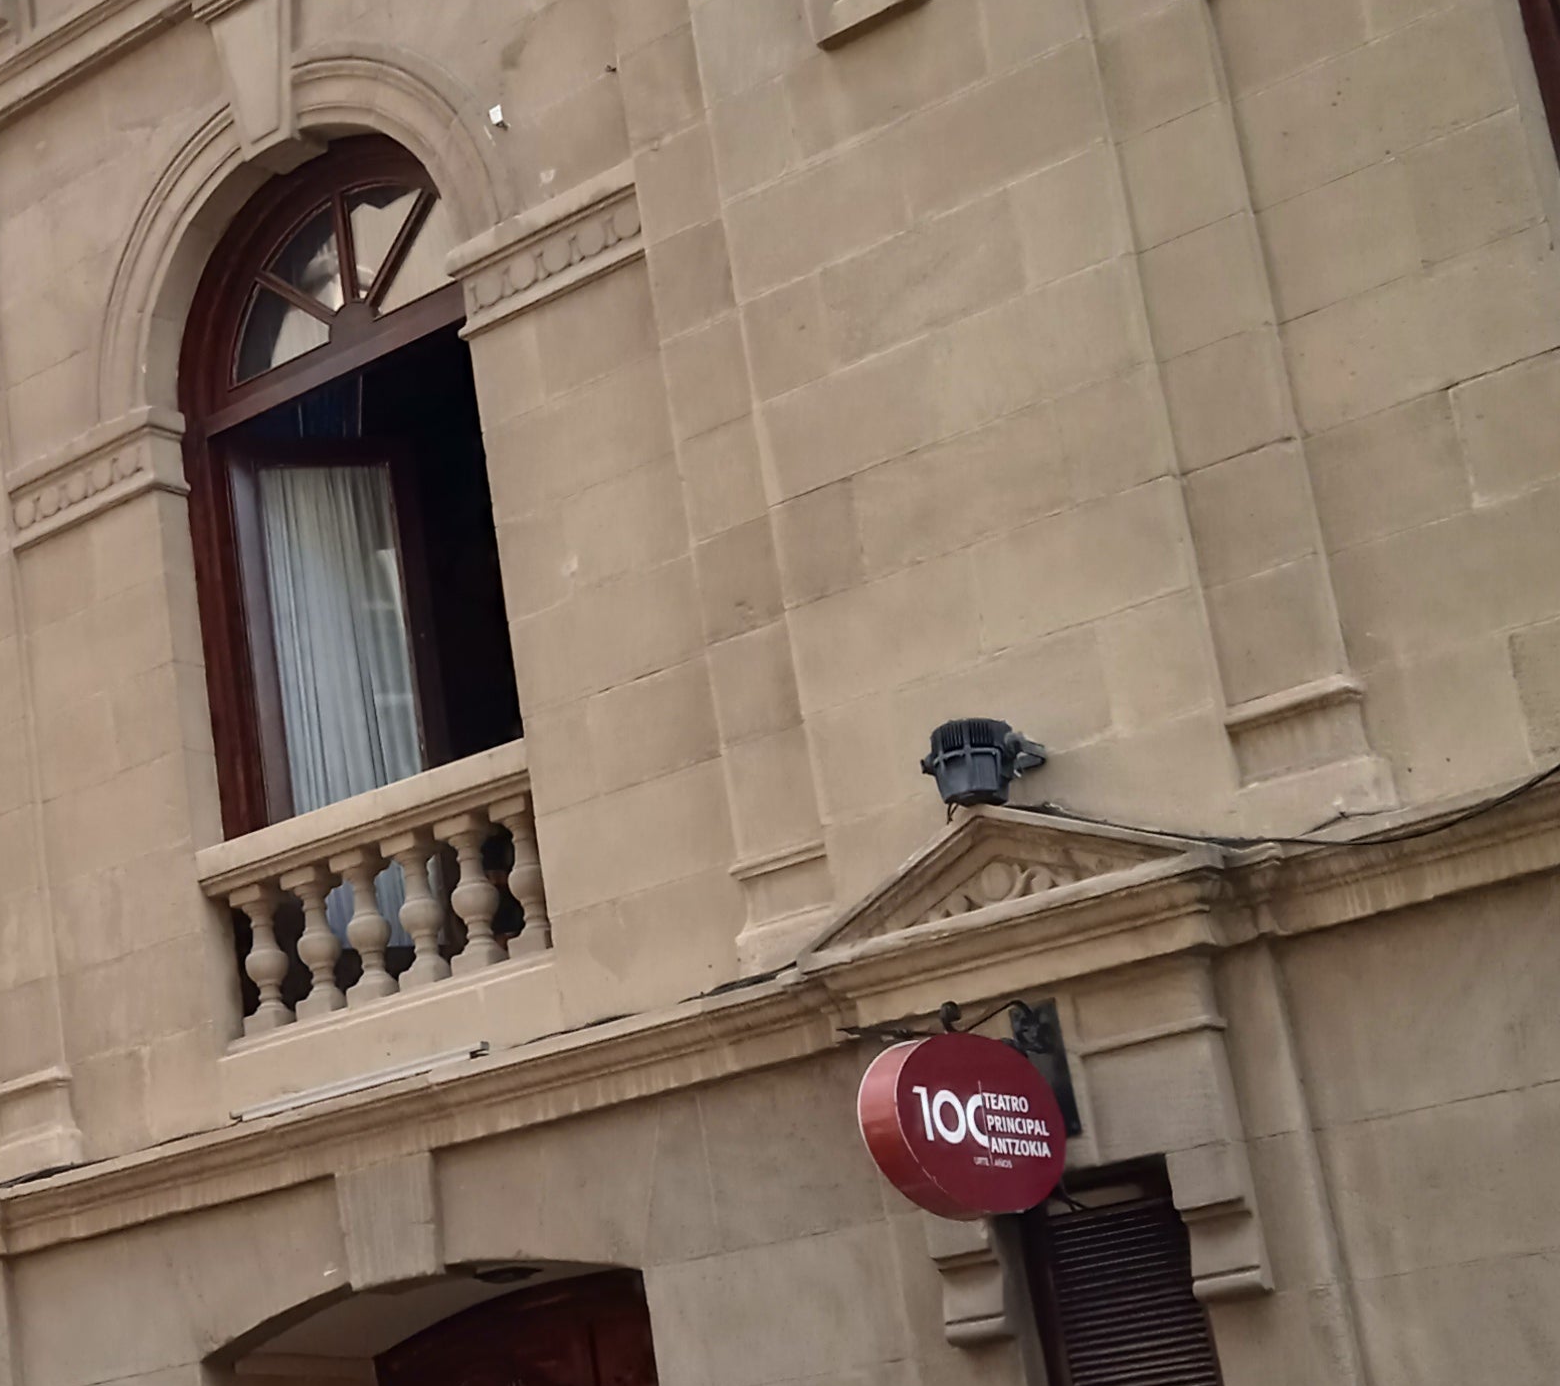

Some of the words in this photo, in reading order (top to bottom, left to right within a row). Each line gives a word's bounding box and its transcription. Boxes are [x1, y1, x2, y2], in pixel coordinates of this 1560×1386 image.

[982, 1091, 1029, 1114] TEATRO
[986, 1114, 1051, 1137] PRINCIPAL
[991, 1136, 1052, 1159] ANTZOKIA
